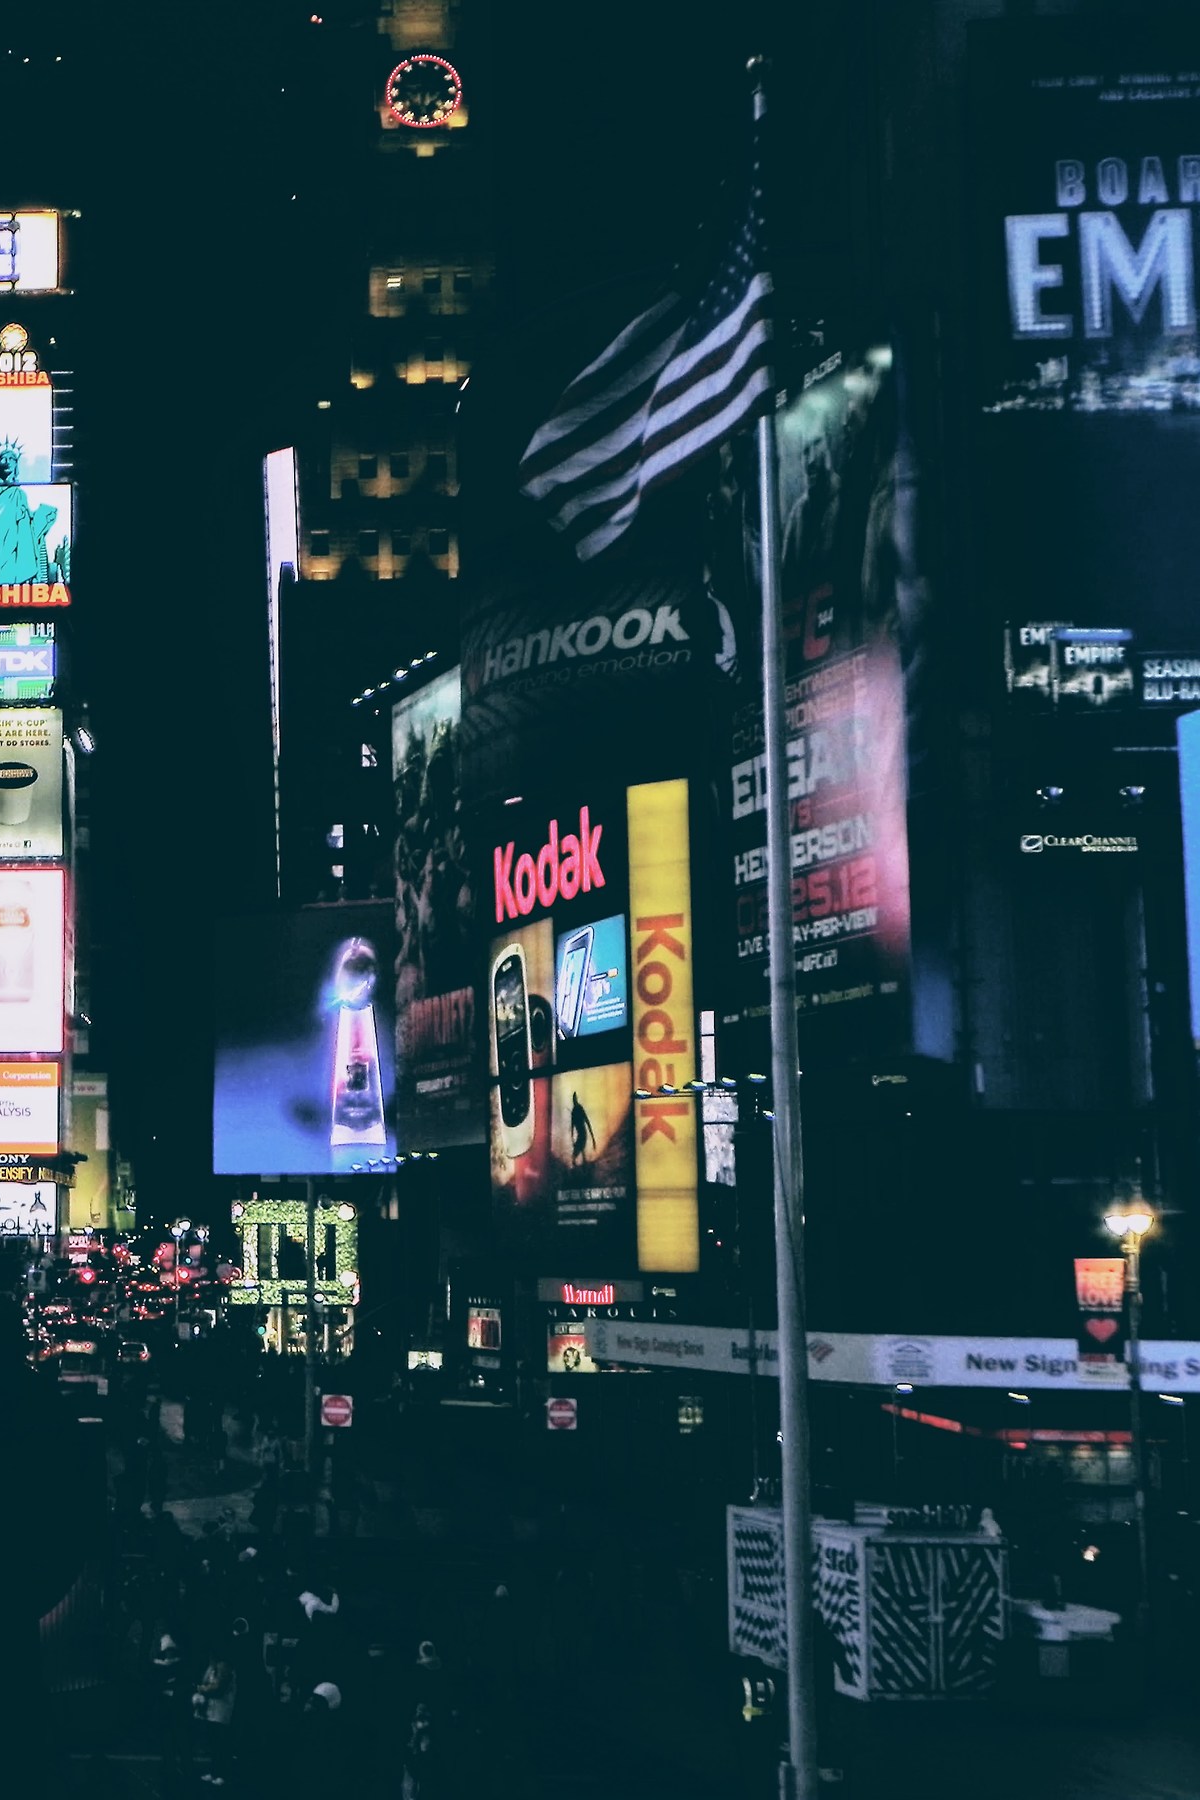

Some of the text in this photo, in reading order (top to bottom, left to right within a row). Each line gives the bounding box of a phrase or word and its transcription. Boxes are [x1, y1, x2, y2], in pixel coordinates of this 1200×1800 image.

[577, 649, 692, 679] emotion
[493, 805, 606, 923] Kodak
[636, 912, 689, 1144] Kodak
[2, 1071, 51, 1081] Corporation
[966, 1352, 1014, 1371] New
[1025, 1353, 1078, 1377] Sign
